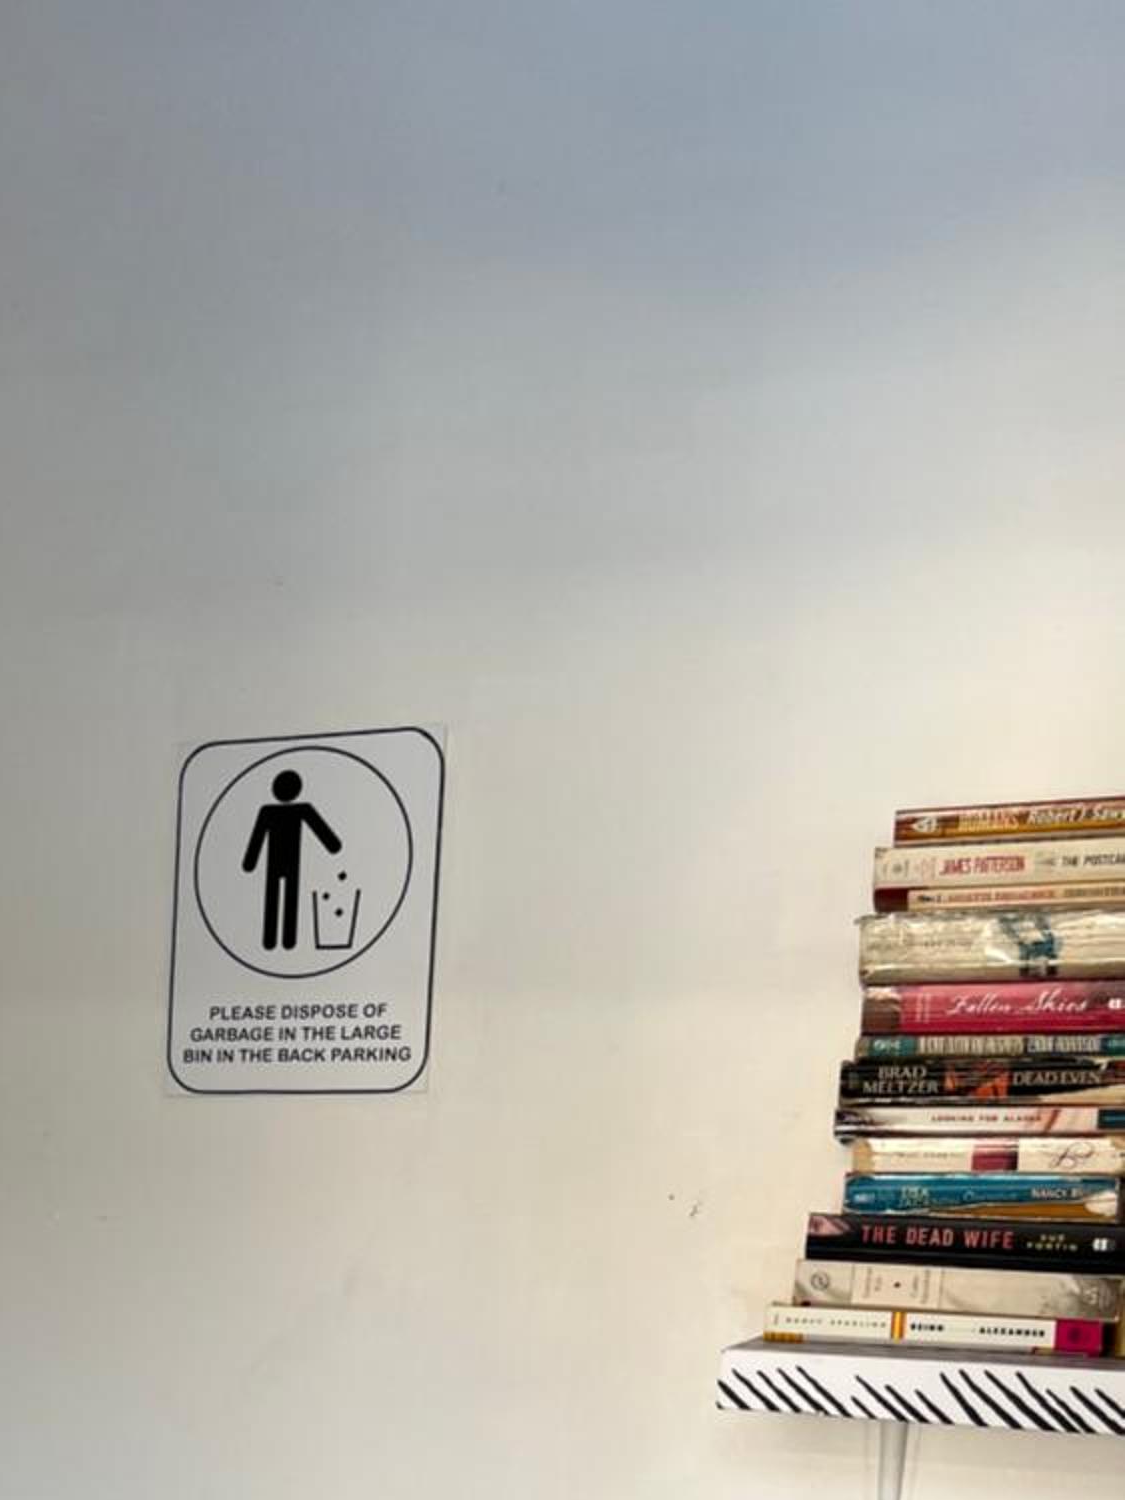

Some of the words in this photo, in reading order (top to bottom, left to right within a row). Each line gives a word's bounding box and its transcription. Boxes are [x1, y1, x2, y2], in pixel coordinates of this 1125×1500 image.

[939, 857, 972, 875] JAMES
[974, 855, 1024, 873] PATTERSON
[946, 991, 1012, 1015] Fallen
[1019, 983, 1088, 1013] Skies
[209, 1005, 277, 1021] PLEASE
[280, 1003, 358, 1020] DISPOSE
[362, 1002, 388, 1018] OF
[190, 1027, 274, 1042] GARBAGE
[278, 1026, 296, 1041] IN
[300, 1026, 336, 1041] THE
[340, 1024, 402, 1040] LARGE
[183, 1048, 212, 1063] BIN
[216, 1048, 234, 1063] IN
[239, 1048, 272, 1063] THE
[277, 1047, 325, 1063] BACK
[330, 1046, 412, 1062] PARKING
[877, 1065, 927, 1079] BRAD
[1013, 1070, 1059, 1086] DEAD
[1060, 1069, 1101, 1084] EVEN
[862, 1080, 939, 1094] MELTZER
[861, 1224, 896, 1244] THE
[905, 1226, 954, 1247] DEAD
[963, 1229, 1014, 1249] WIFE
[979, 1327, 1045, 1338] ALEXANDER
